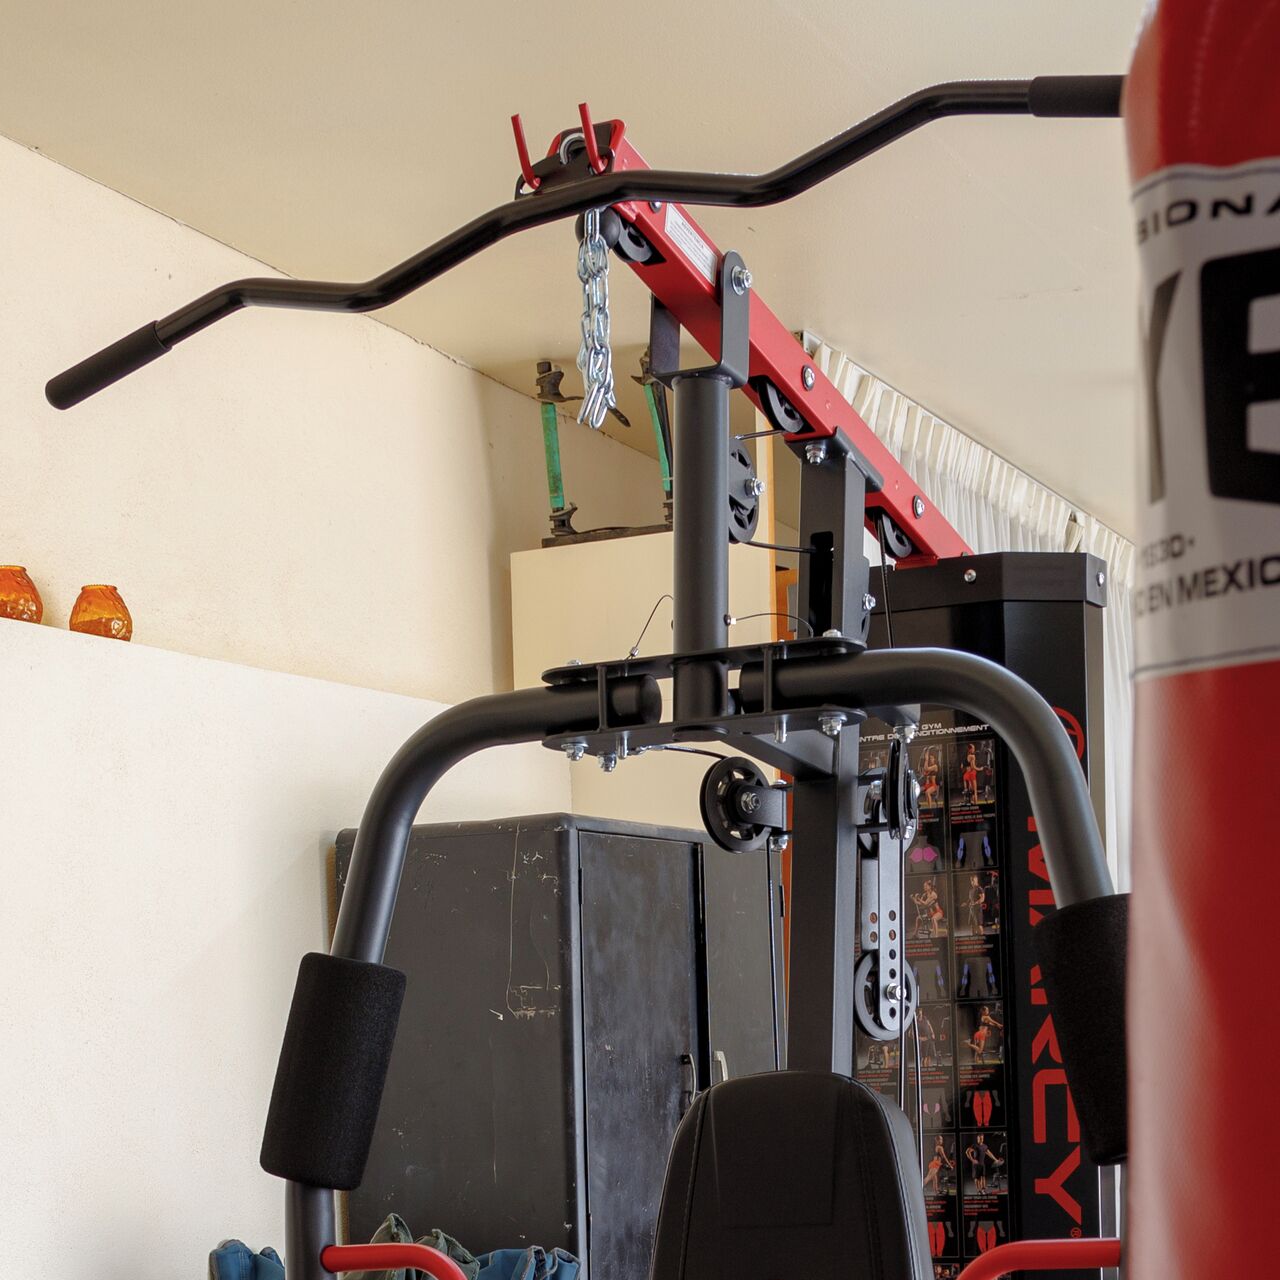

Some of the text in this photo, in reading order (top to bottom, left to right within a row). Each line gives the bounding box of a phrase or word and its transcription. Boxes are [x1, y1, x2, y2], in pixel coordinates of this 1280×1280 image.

[1148, 579, 1174, 612] EN
[859, 733, 885, 743] NTRE
[913, 724, 990, 738] NDITIONNEMENT
[921, 722, 942, 731] GYM
[1027, 815, 1083, 1227] RCY
